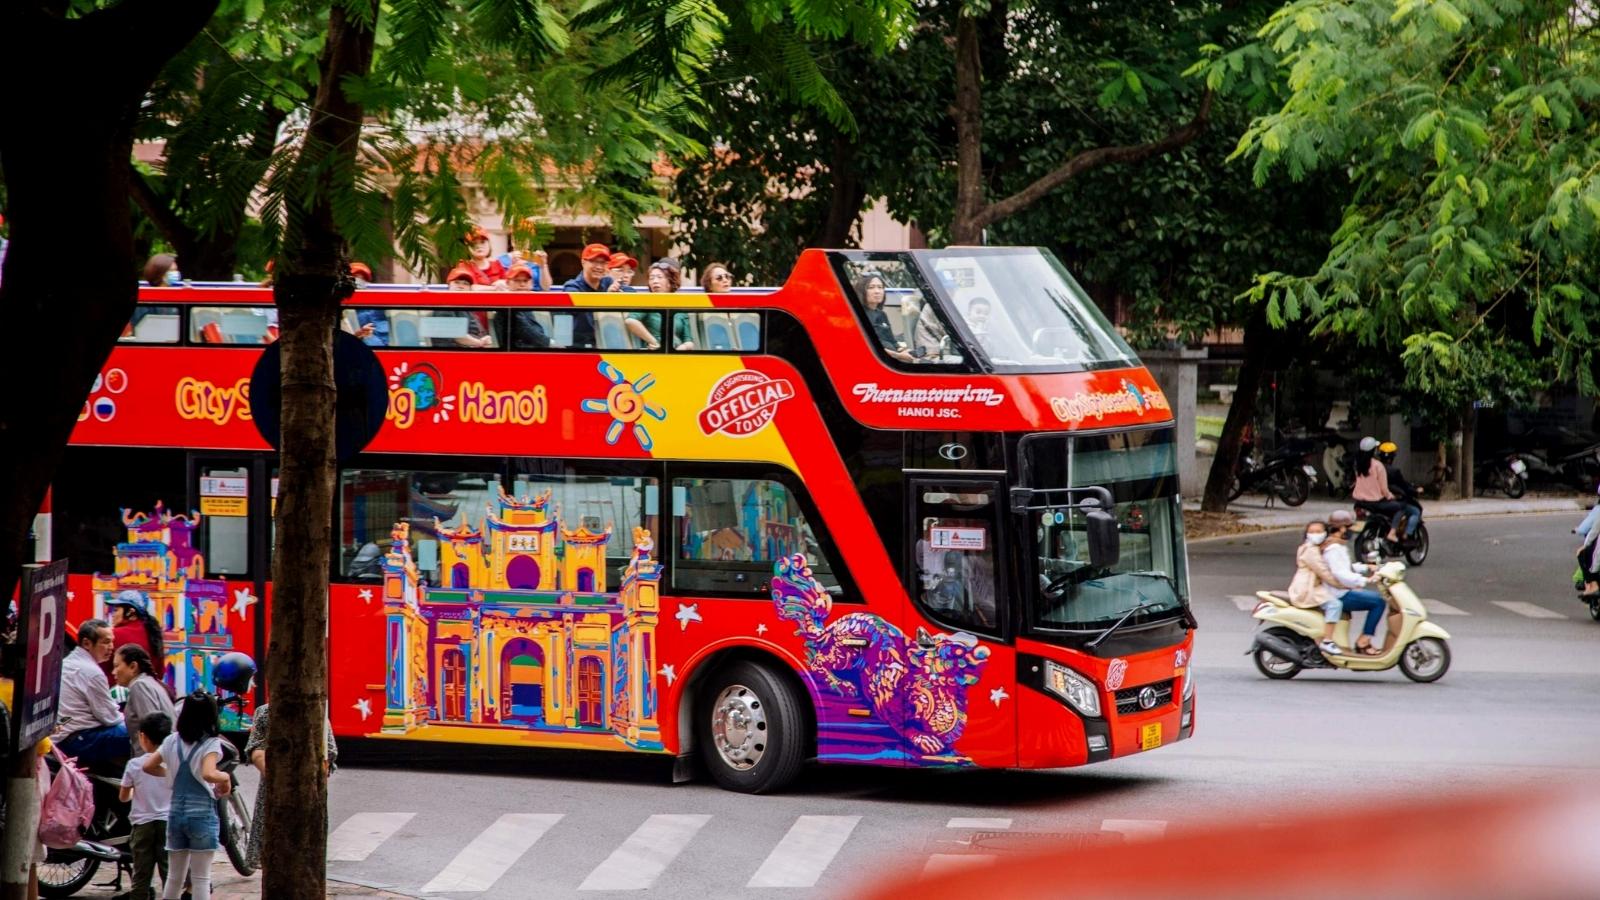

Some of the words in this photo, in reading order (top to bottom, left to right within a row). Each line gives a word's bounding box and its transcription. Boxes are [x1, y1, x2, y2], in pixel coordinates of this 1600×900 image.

[713, 385, 727, 401] CITY
[723, 374, 765, 389] SIGHTSEEING
[852, 382, 1004, 406] Vietnamtourism
[459, 381, 547, 425] Hanoi
[706, 382, 789, 428] OFFICIAL
[898, 407, 934, 417] HANOI
[936, 408, 962, 418] JSC.
[735, 408, 771, 432] TOUR
[35, 595, 57, 694] P
